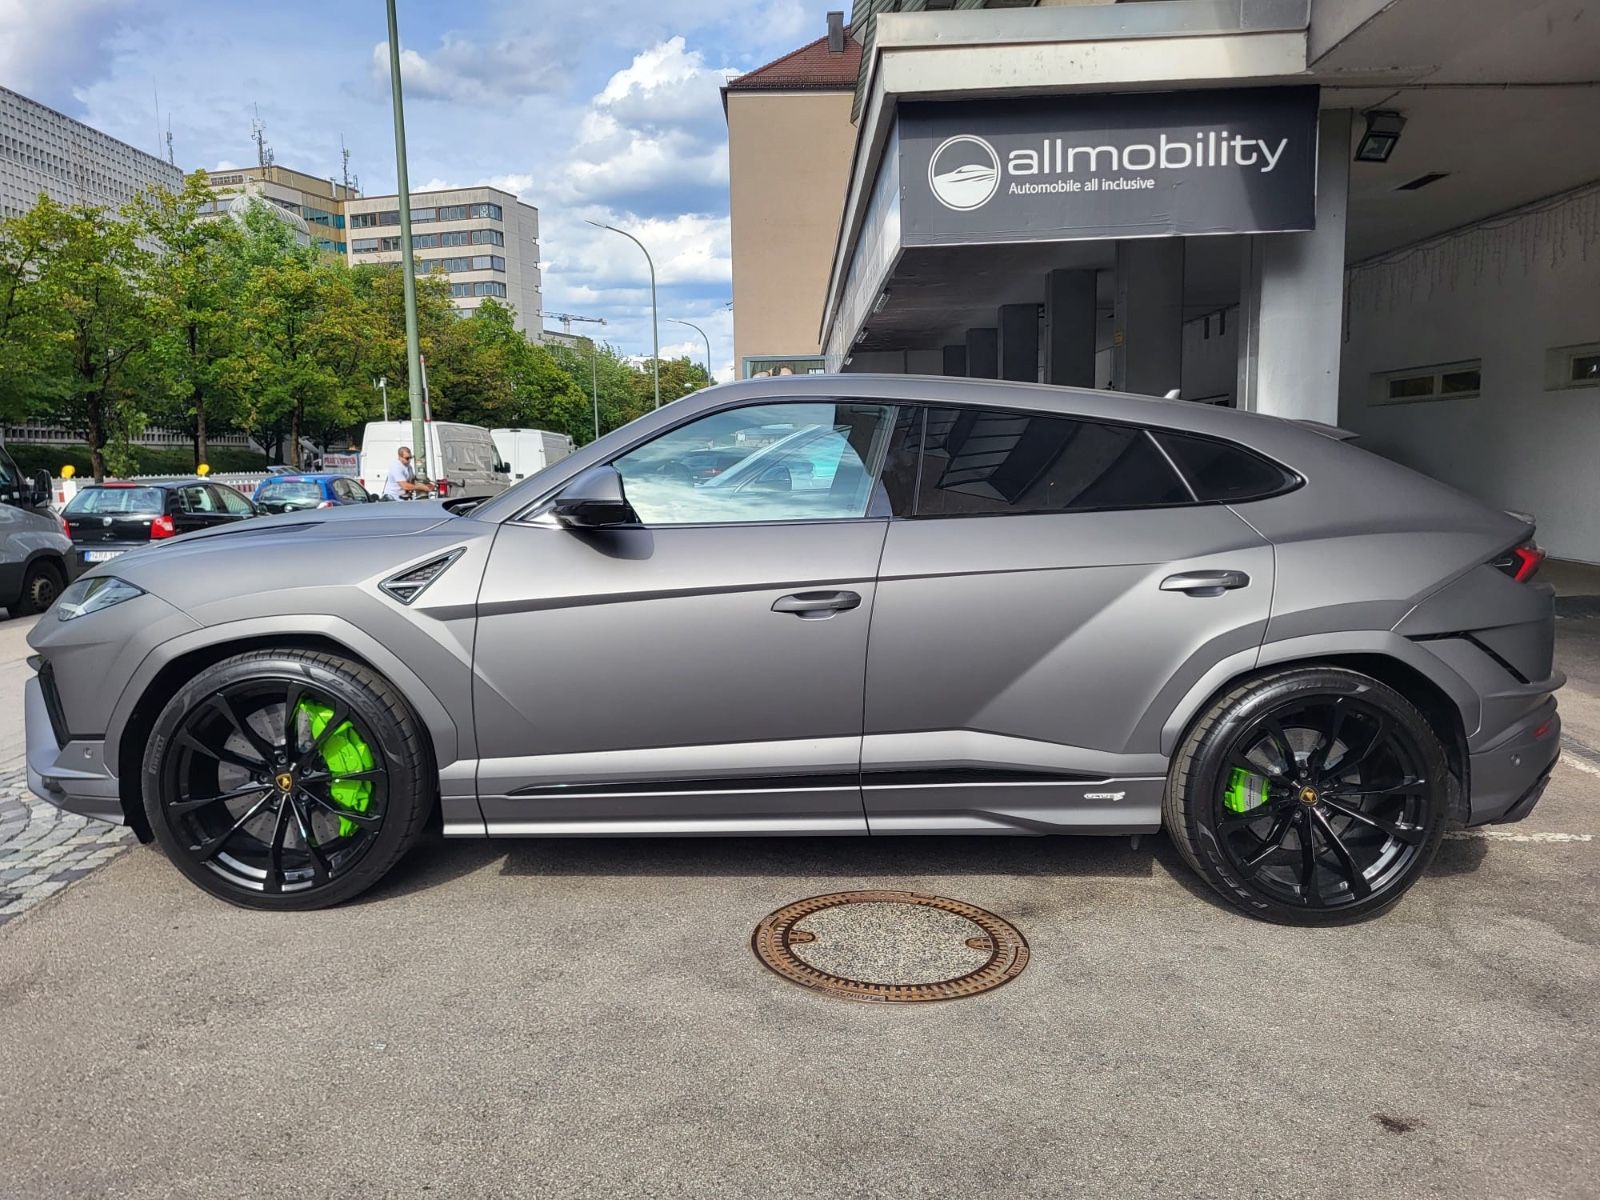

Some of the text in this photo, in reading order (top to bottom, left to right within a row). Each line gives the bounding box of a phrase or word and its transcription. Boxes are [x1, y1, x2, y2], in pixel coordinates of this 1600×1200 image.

[1008, 131, 1288, 175] allmobility
[1008, 176, 1155, 194] Automobile all inclusive
